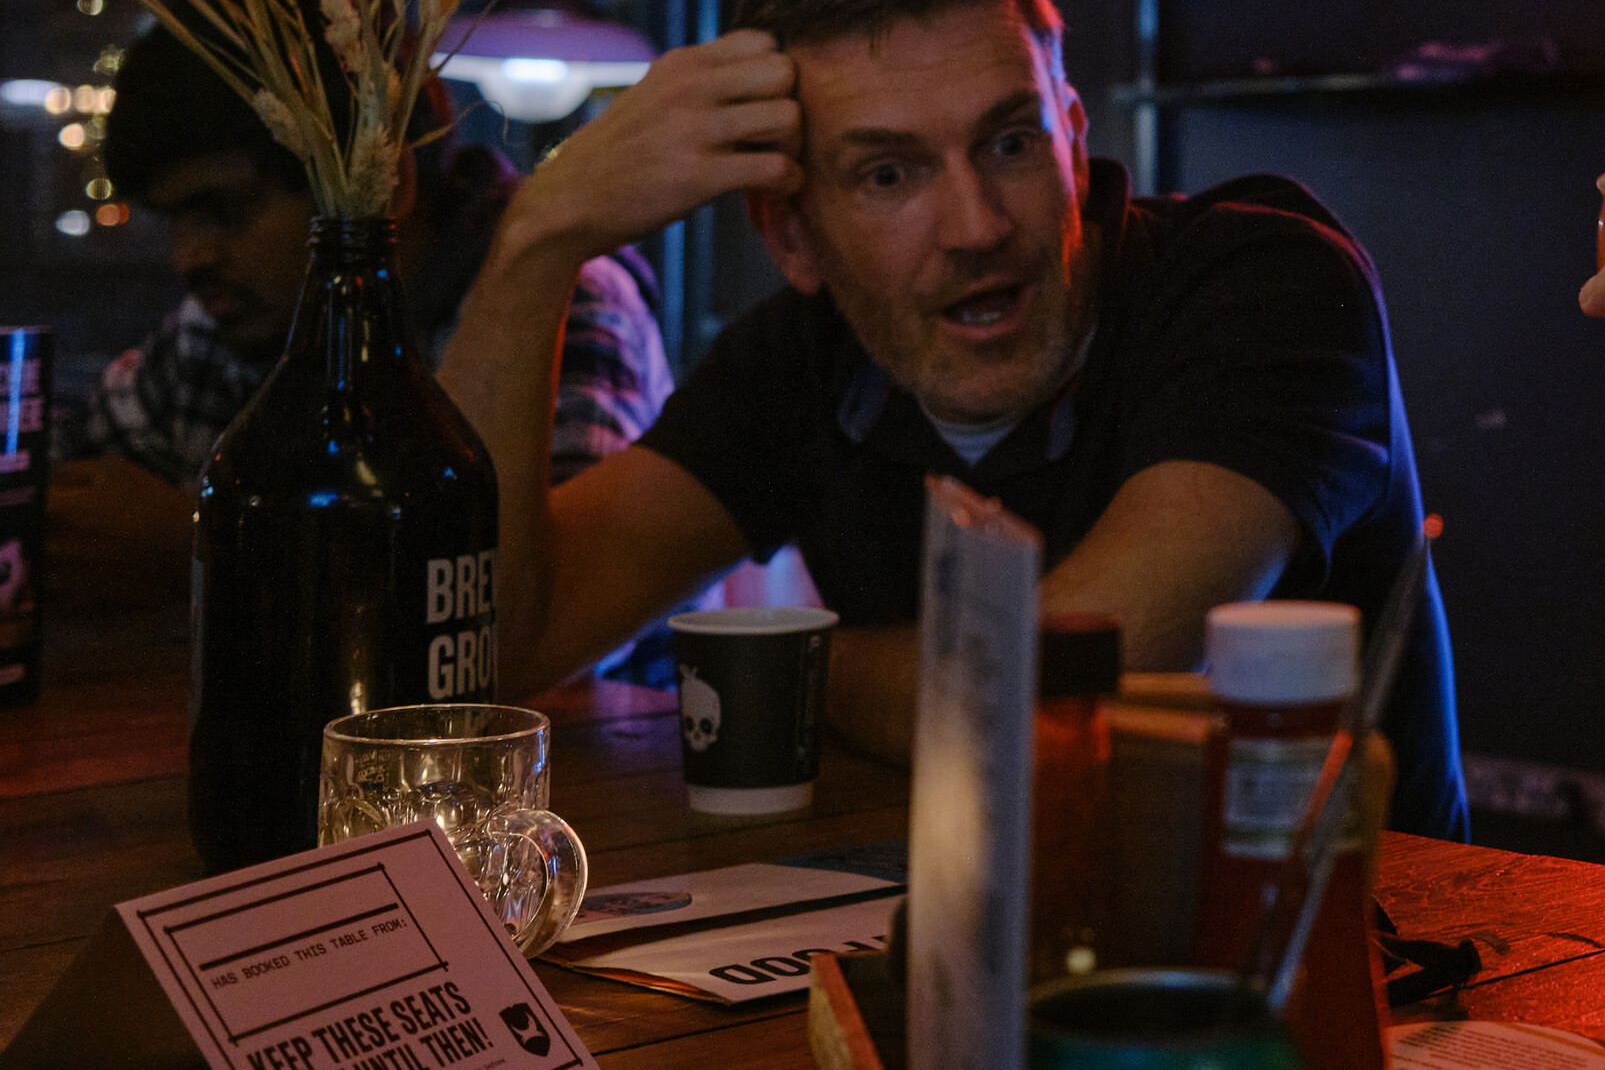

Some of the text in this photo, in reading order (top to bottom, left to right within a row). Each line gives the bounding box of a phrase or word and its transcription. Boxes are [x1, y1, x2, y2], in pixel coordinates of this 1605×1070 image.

[427, 548, 497, 624] BRE
[428, 627, 493, 700] GRO
[212, 918, 408, 989] HAS BOOKED THIS TABLE FROM:
[311, 1007, 401, 1064] THESE
[390, 981, 471, 1035] SEATS
[419, 1017, 494, 1068] THEN!
